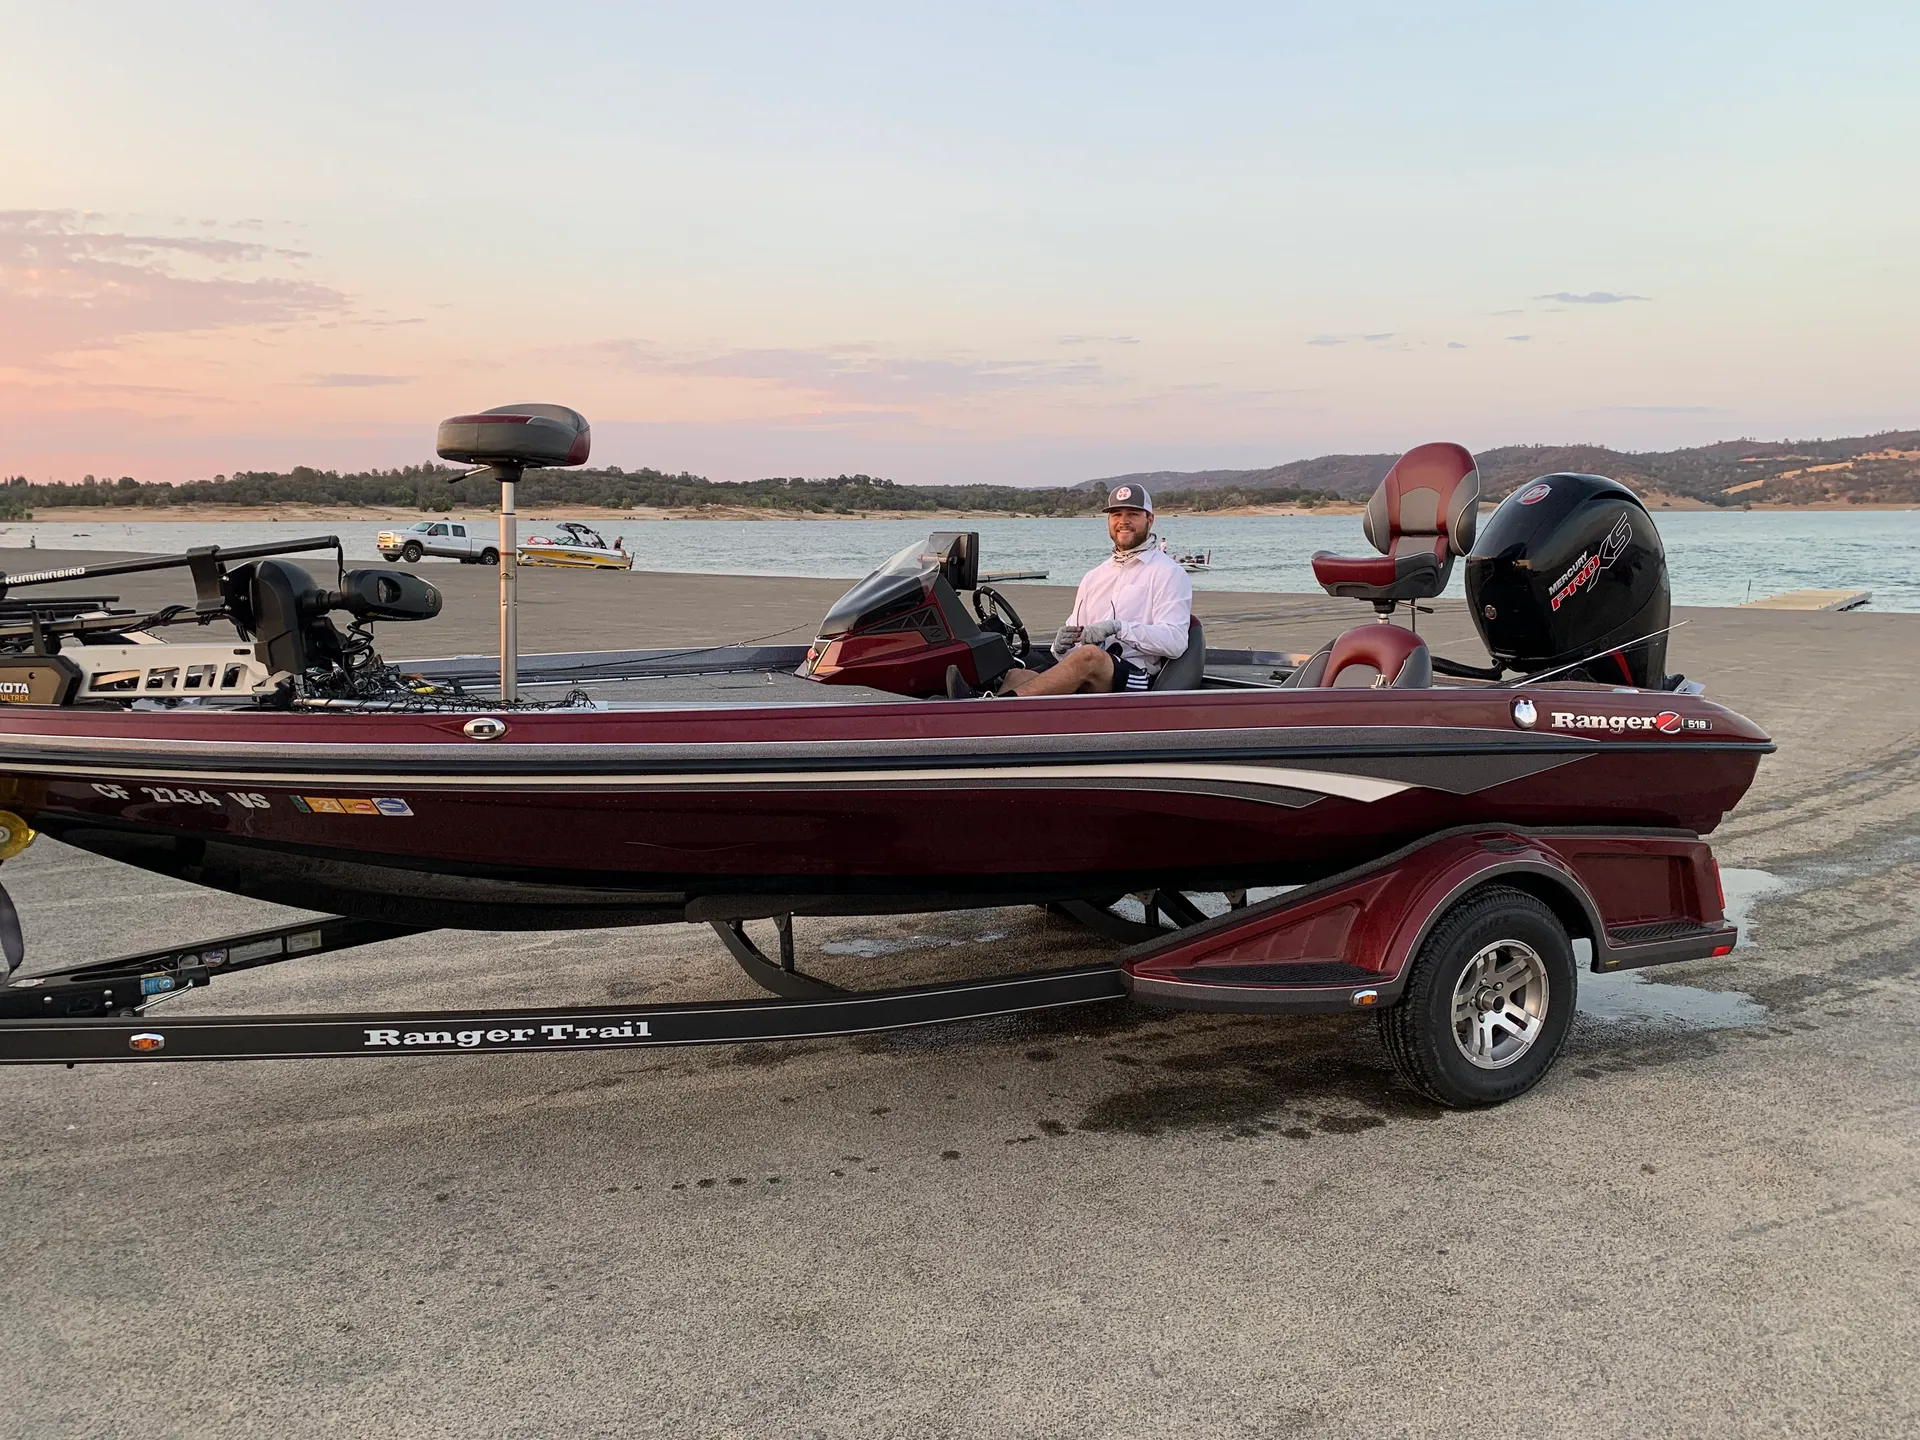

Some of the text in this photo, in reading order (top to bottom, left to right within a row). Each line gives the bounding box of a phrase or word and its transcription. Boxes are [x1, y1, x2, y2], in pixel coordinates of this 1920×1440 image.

[5, 567, 85, 584] HUMMINBIRD
[1548, 550, 1588, 596] MERCURY
[1551, 554, 1600, 612] PRO
[1551, 712, 1657, 734] Ranger
[1688, 719, 1706, 729] 518
[91, 783, 271, 809] CF 2284 VS
[363, 1020, 652, 1047] Ranger Trail
